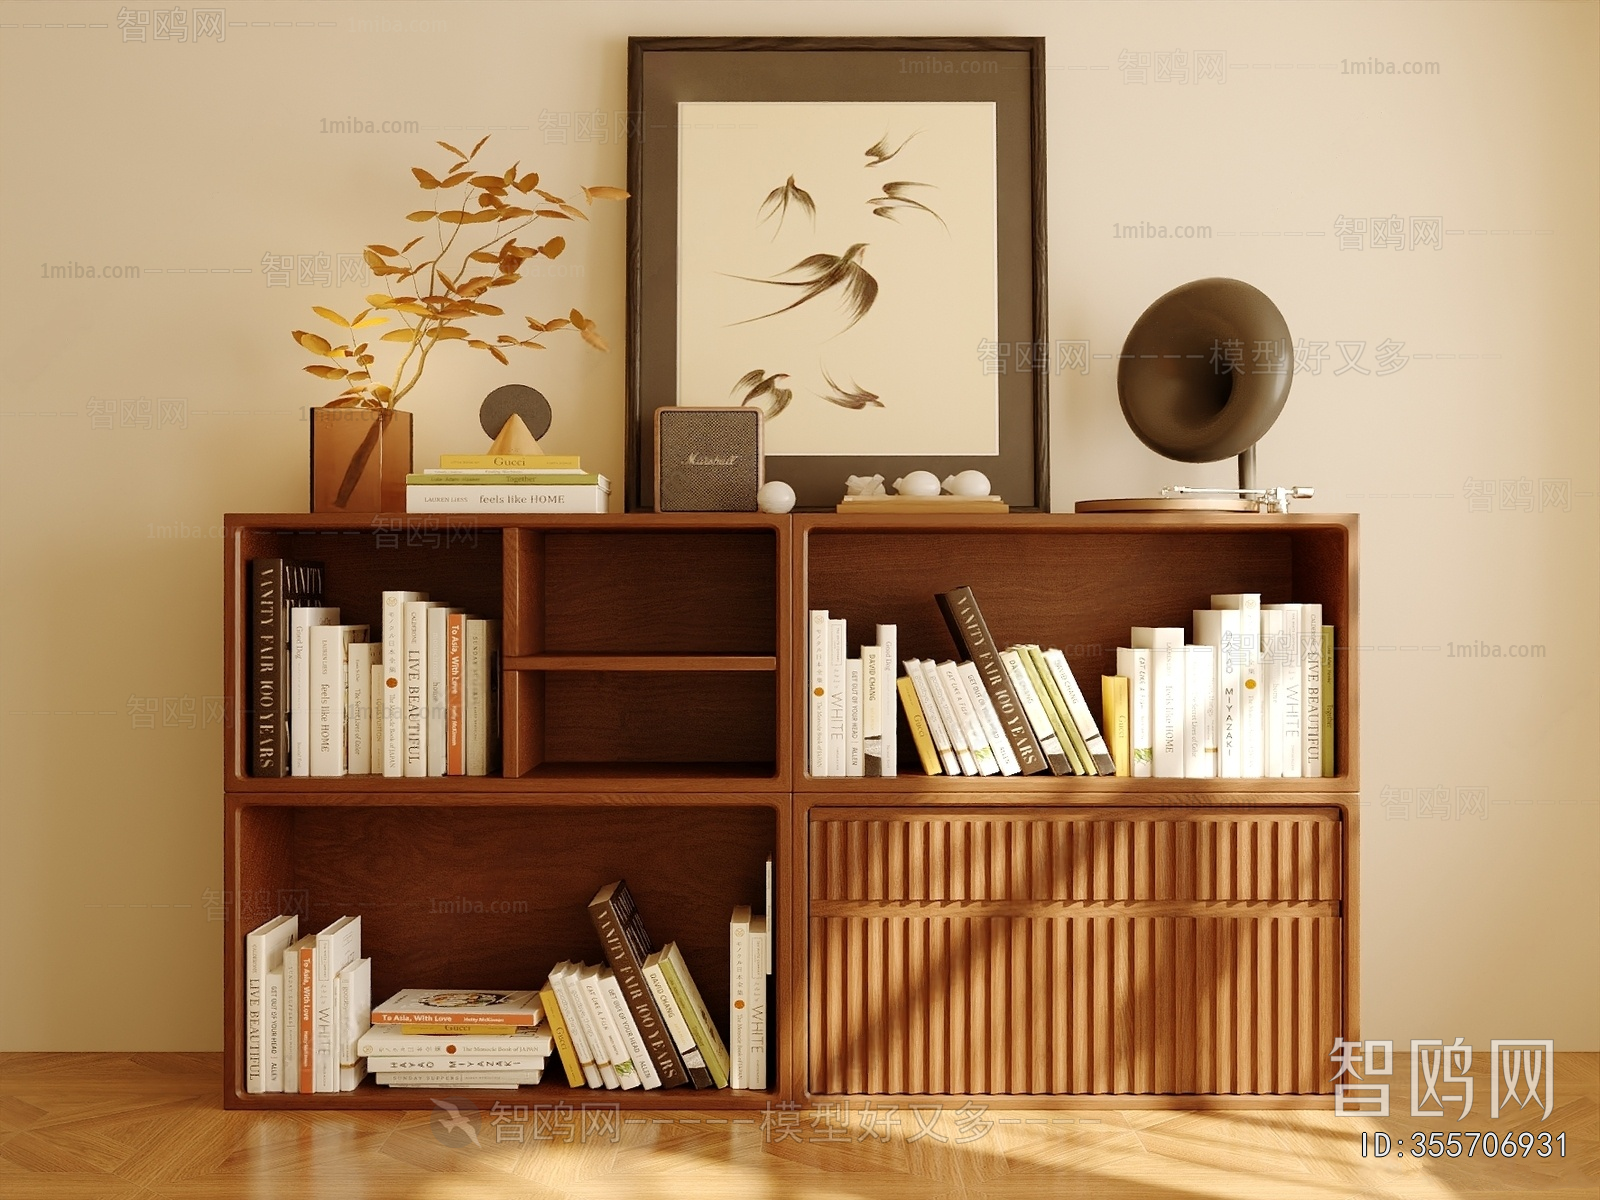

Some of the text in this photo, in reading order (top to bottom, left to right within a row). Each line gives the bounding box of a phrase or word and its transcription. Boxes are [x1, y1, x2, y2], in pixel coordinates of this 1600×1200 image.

[493, 457, 526, 466] Gucci
[479, 494, 504, 504] feels
[506, 494, 527, 504] like
[530, 495, 565, 504] HOME
[294, 626, 303, 643] Good
[294, 645, 303, 659] Dog
[884, 641, 892, 657] Good
[260, 569, 274, 768] VANITY FAIR 100 YEARS
[451, 625, 460, 695] To Asia, With Love
[884, 659, 892, 671] Dog
[432, 682, 440, 702] home
[957, 596, 1037, 766] VANITY FAIR 100 YEARS
[1054, 658, 1077, 705] DAVID CHANG
[321, 684, 330, 753] feels like HOME
[408, 650, 420, 764] LIVE BEAUTIFUL
[831, 692, 843, 740] WHITE
[851, 696, 858, 705] OF
[1286, 684, 1299, 738] WHITE
[1307, 652, 1319, 764] LIVE BEAUTIFUL
[914, 713, 926, 738] Gucci
[1118, 715, 1126, 739] Gucci
[1165, 725, 1173, 753] HOME
[1225, 688, 1233, 757] MIYAZAKI
[303, 958, 310, 967] To
[597, 911, 625, 960] VANITY
[620, 965, 644, 1000] FAIR
[636, 1003, 655, 1030] 100
[648, 1029, 678, 1079] YEARS
[649, 972, 674, 1018] DAVID CHANG
[249, 979, 260, 1080] LIVE BEAUTIFUL
[271, 1012, 277, 1020] OF
[318, 1007, 331, 1056] WHITE
[382, 1014, 391, 1022] To
[393, 1014, 412, 1022] Asia,
[414, 1014, 433, 1022] With
[608, 988, 650, 1079] GET OUT OF YOUR HEAD ALLEN
[752, 1005, 764, 1053] WHITE
[555, 1026, 569, 1051] Gucci
[390, 1060, 521, 1069] HAYAO MIYAZAKI
